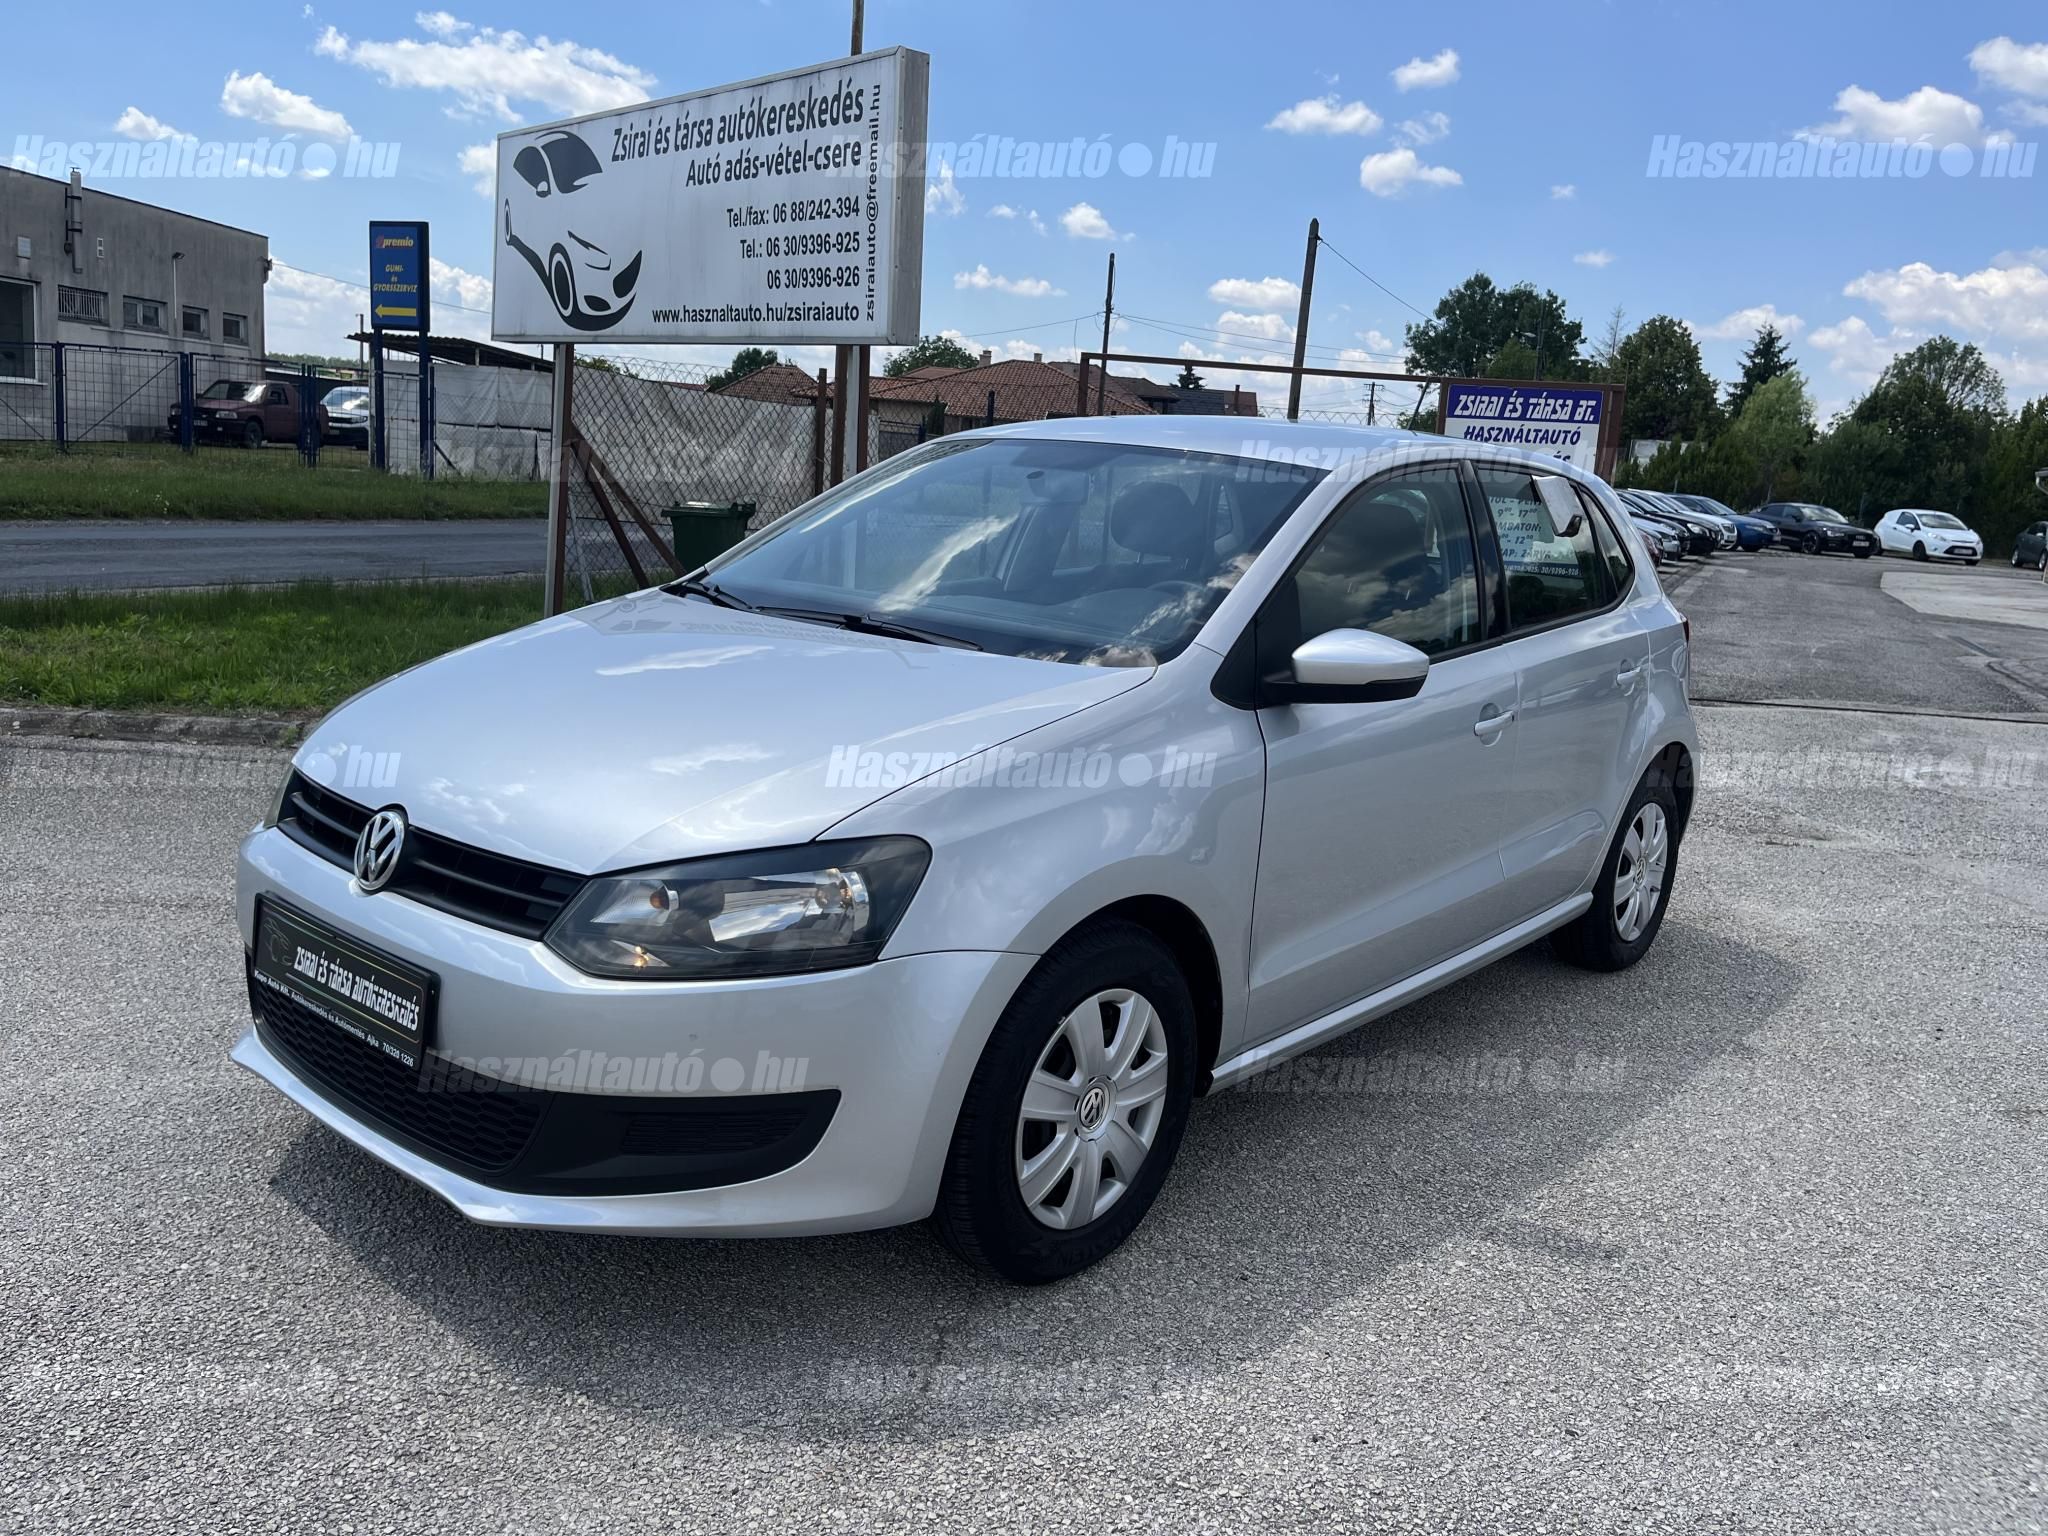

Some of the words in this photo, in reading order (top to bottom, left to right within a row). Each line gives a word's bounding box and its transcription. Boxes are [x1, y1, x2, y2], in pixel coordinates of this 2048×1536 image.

[611, 123, 652, 162] Zsirai
[654, 117, 670, 155] és
[673, 110, 714, 151] társa
[717, 77, 865, 144] autókereskedés
[686, 156, 721, 187] Autó
[724, 137, 862, 182] adás-vétel-csere
[726, 206, 769, 228] Tel./fax:
[773, 202, 787, 223] 06
[790, 198, 860, 223] 88/242-394
[865, 84, 881, 322] zsiraiauto@freemail.hu
[383, 237, 414, 248] premio
[740, 239, 762, 259] Tel.:
[766, 236, 781, 258] 06
[784, 232, 860, 257] 30/9396-925
[767, 270, 781, 290] 06
[784, 266, 860, 289] 30/9396-926
[652, 301, 859, 324] www.hasznaltauto.hu/zsiraiauto
[1454, 394, 1504, 416] ZSIRAI
[1504, 391, 1525, 418] ÉS
[1527, 392, 1573, 420] TÁRSA
[1574, 400, 1597, 422] BT.
[1464, 424, 1581, 445] HASZNÁLTAUTÓ
